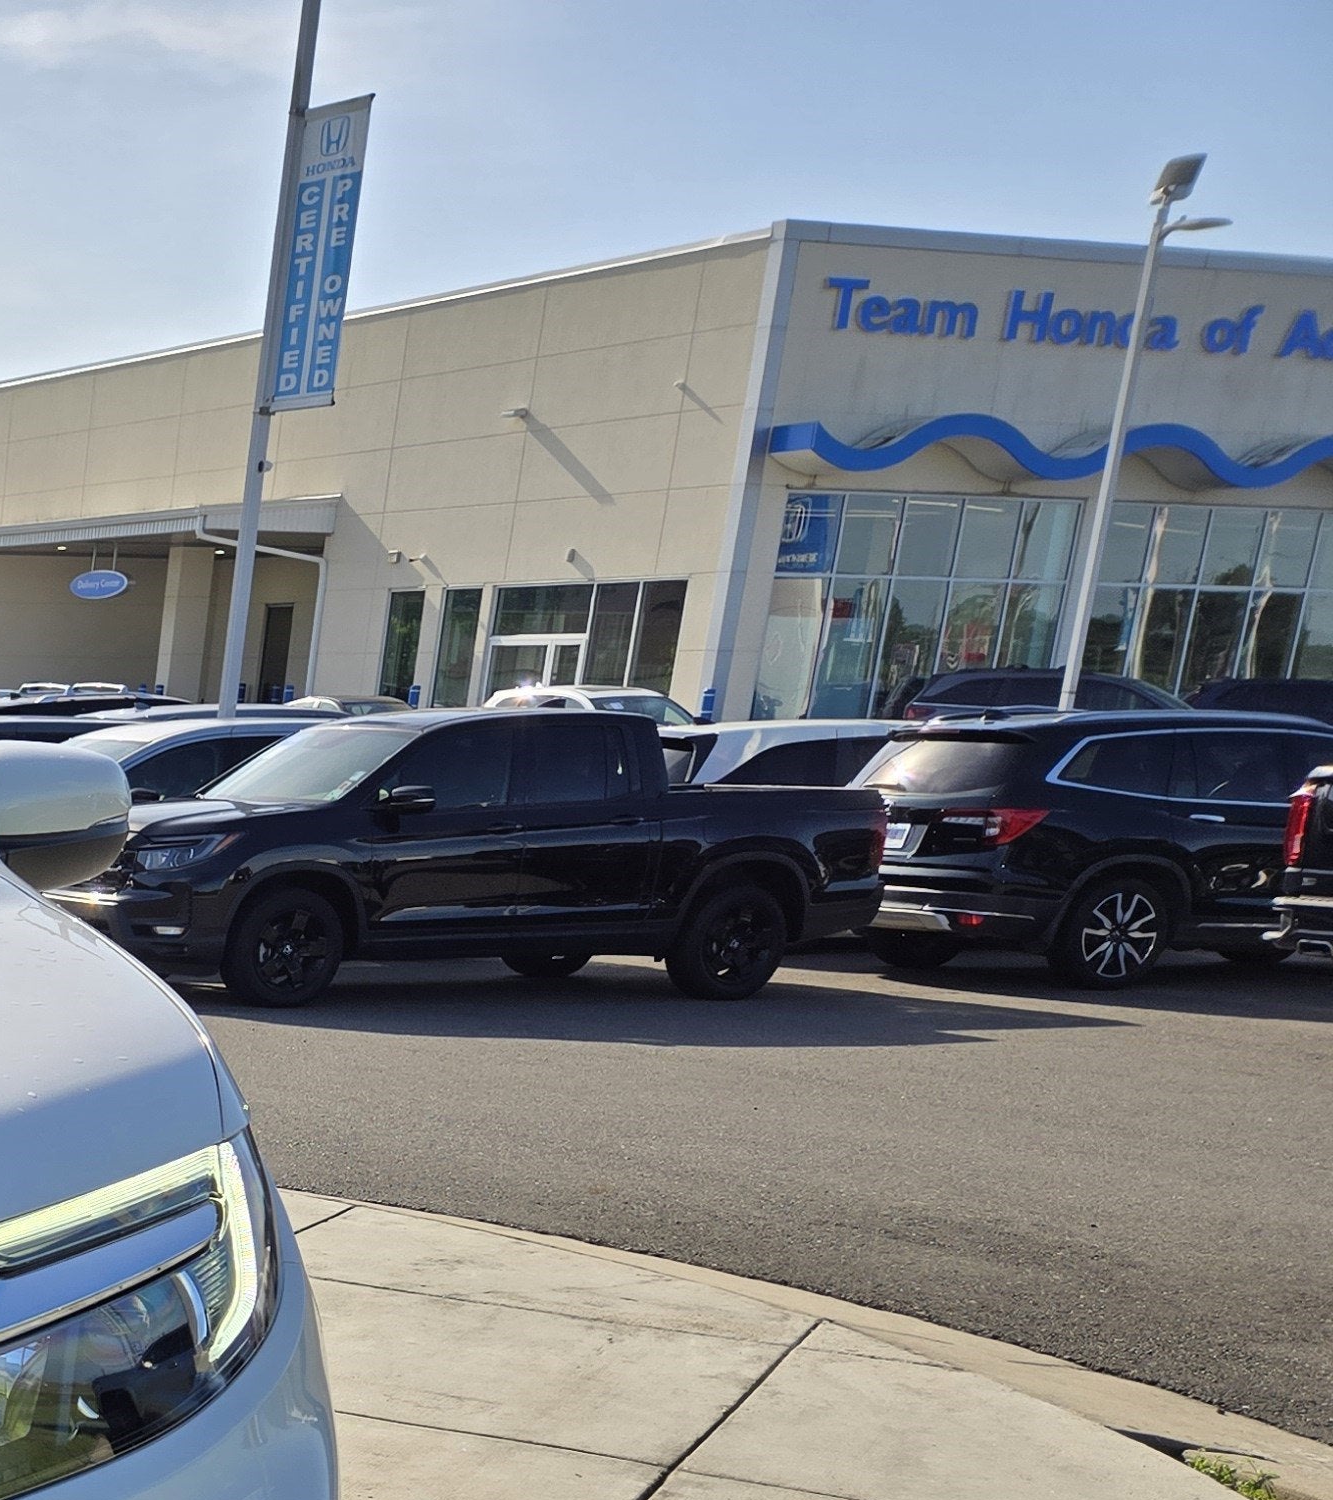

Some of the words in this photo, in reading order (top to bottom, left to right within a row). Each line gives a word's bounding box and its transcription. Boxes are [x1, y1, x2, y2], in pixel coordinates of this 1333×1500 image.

[306, 156, 356, 176] HONDA
[330, 177, 354, 248] PRE
[278, 185, 321, 392] CERTIFIED
[824, 275, 979, 341] Team
[1202, 304, 1266, 356] of
[312, 274, 343, 388] OWNED
